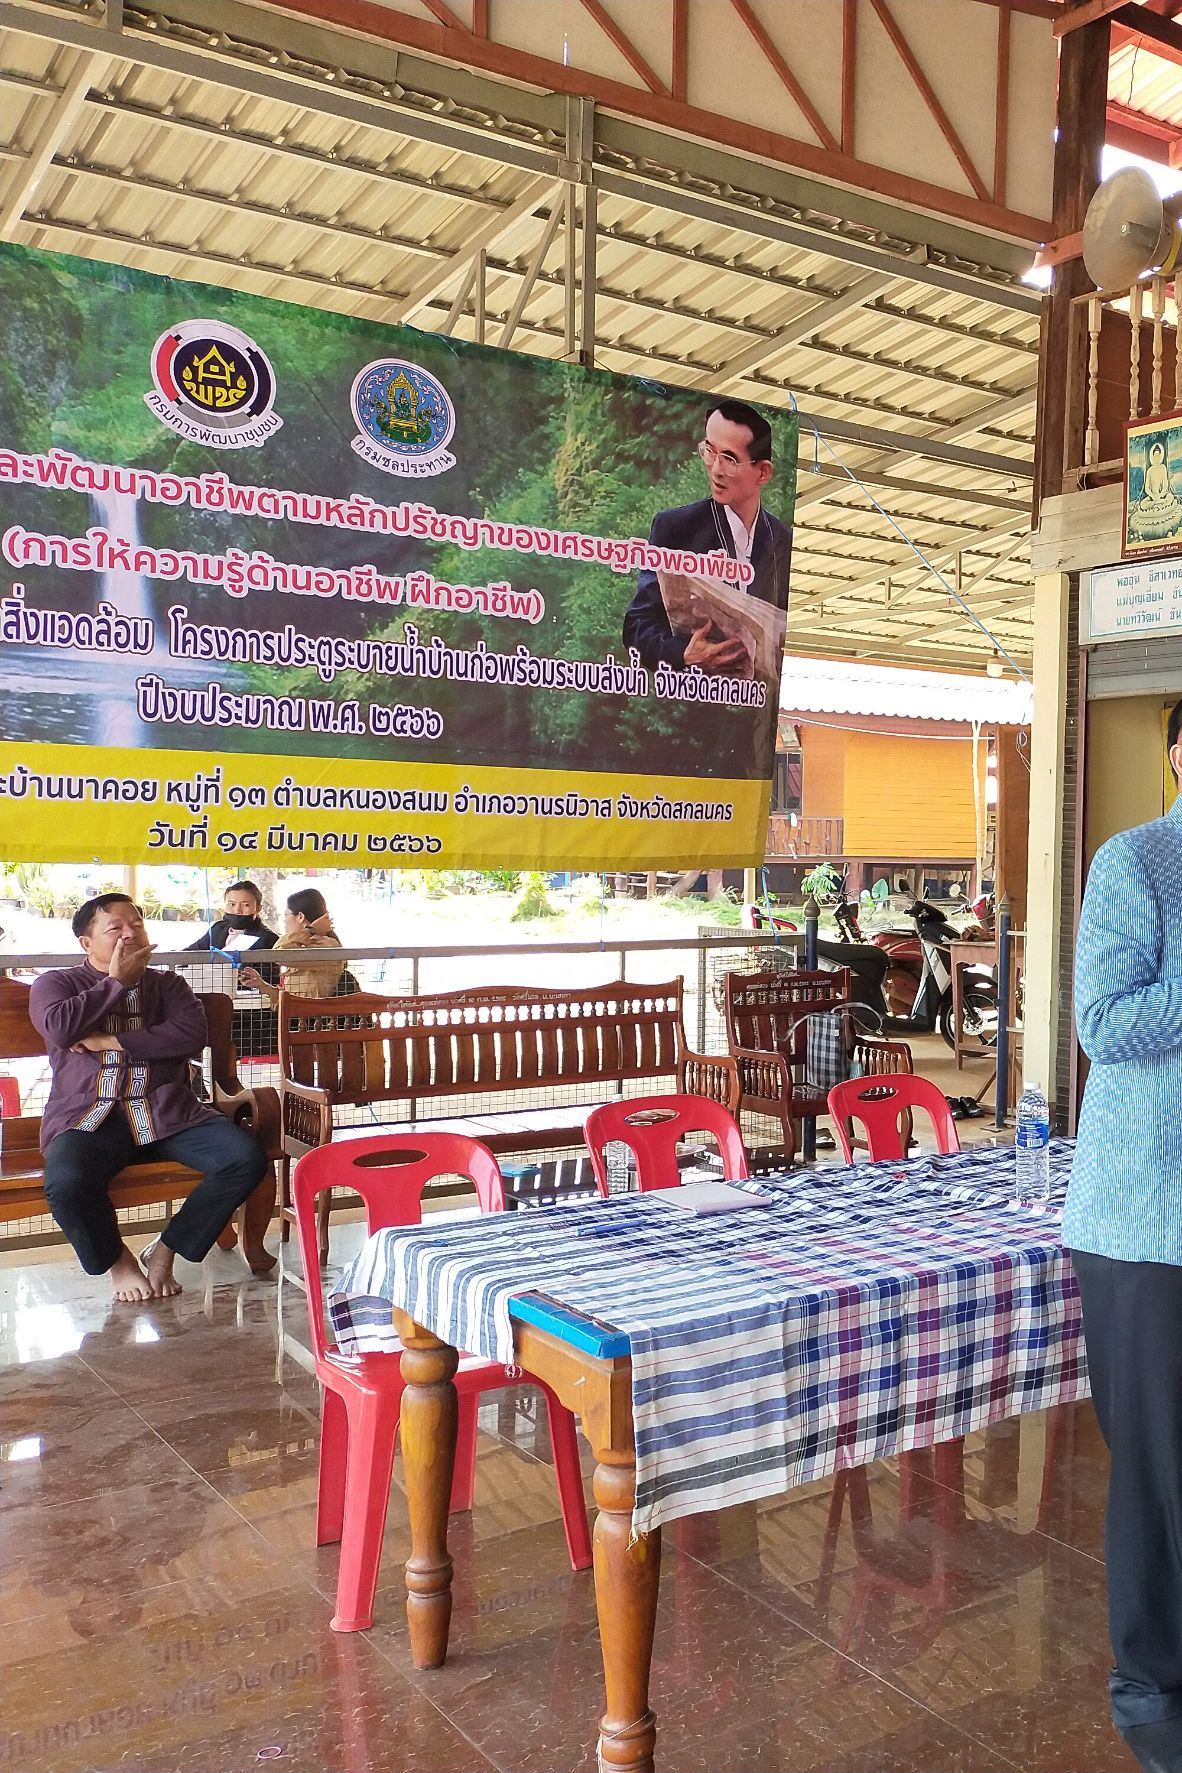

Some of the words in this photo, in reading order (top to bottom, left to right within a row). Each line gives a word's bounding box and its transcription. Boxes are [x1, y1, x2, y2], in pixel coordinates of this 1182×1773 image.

[149, 394, 279, 445] กรมการพัฒนาชุมชน
[355, 439, 452, 474] กรมชลประทาน
[8, 531, 400, 601] (การให้ความรู้ด้านอาชีพ
[411, 575, 542, 620] ฝึกอาชีพ)
[3, 585, 151, 651] สิ่งแวดล้อม
[171, 608, 647, 696] โครงการประตูระบายน้ำบ้านก่อพร้อมระบบส่งน้ำ
[656, 663, 767, 707] จังหวัดสกลนคร
[141, 678, 303, 728] ปีงบประมาณ
[312, 702, 365, 732] พ.ศ.
[371, 705, 442, 737] ๒๕๖๖
[167, 767, 221, 812] หมู่ที่
[229, 786, 266, 808] ๑๓
[274, 778, 448, 812] ตำบลหนองสนม
[455, 785, 612, 818] อำเภอวานรนิวาส
[617, 793, 733, 821] จังหวัดสกลนคร
[148, 815, 209, 848] วันที่
[217, 831, 259, 852] ๑๔
[268, 824, 358, 852] มีนาคม
[367, 833, 442, 854] ๒๕๖๖
